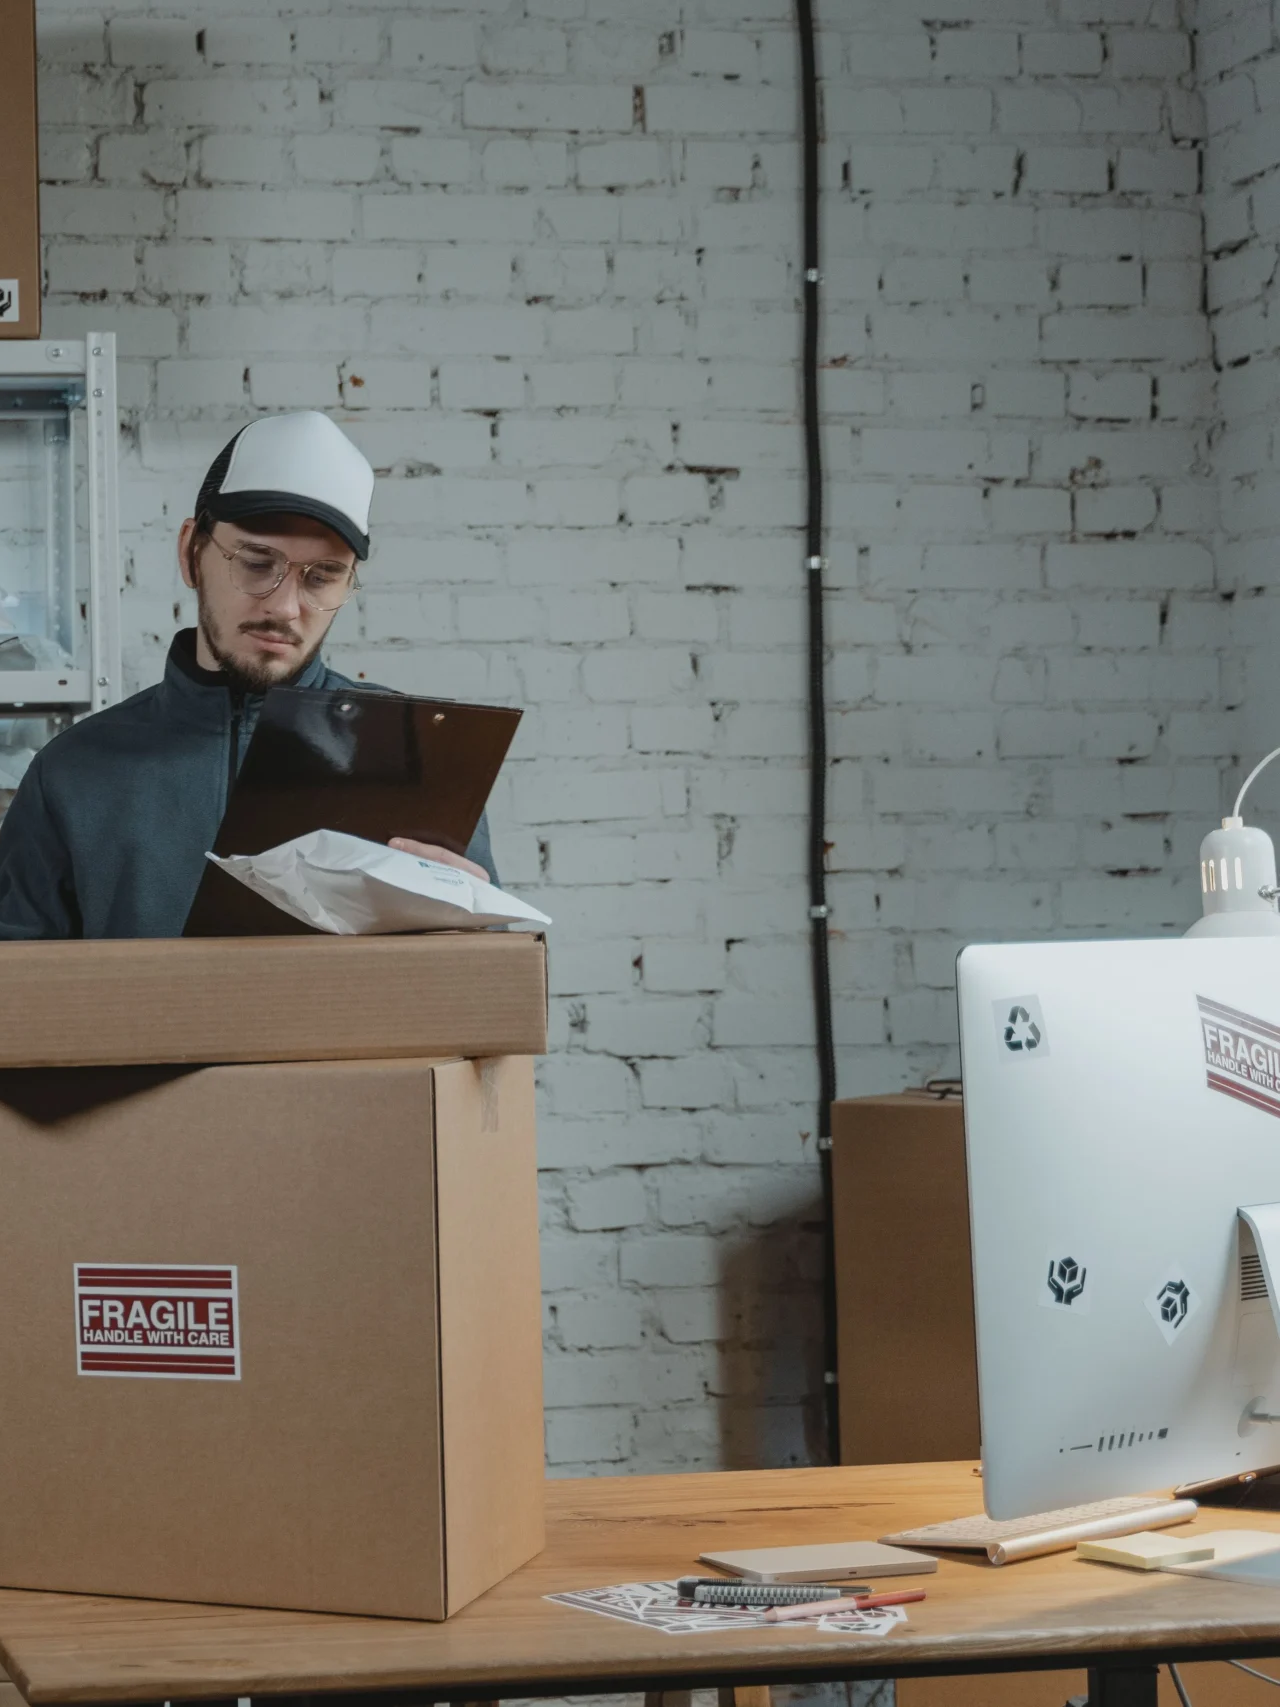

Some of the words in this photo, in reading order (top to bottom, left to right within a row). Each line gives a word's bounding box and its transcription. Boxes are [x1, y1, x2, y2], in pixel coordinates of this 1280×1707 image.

[1208, 1050, 1248, 1078] HANDLE
[1249, 1067, 1274, 1088] WITH
[82, 1299, 230, 1331] FRAGILE
[83, 1329, 143, 1344] HANDLE
[146, 1330, 184, 1345] WITH
[187, 1331, 230, 1346] CARE
